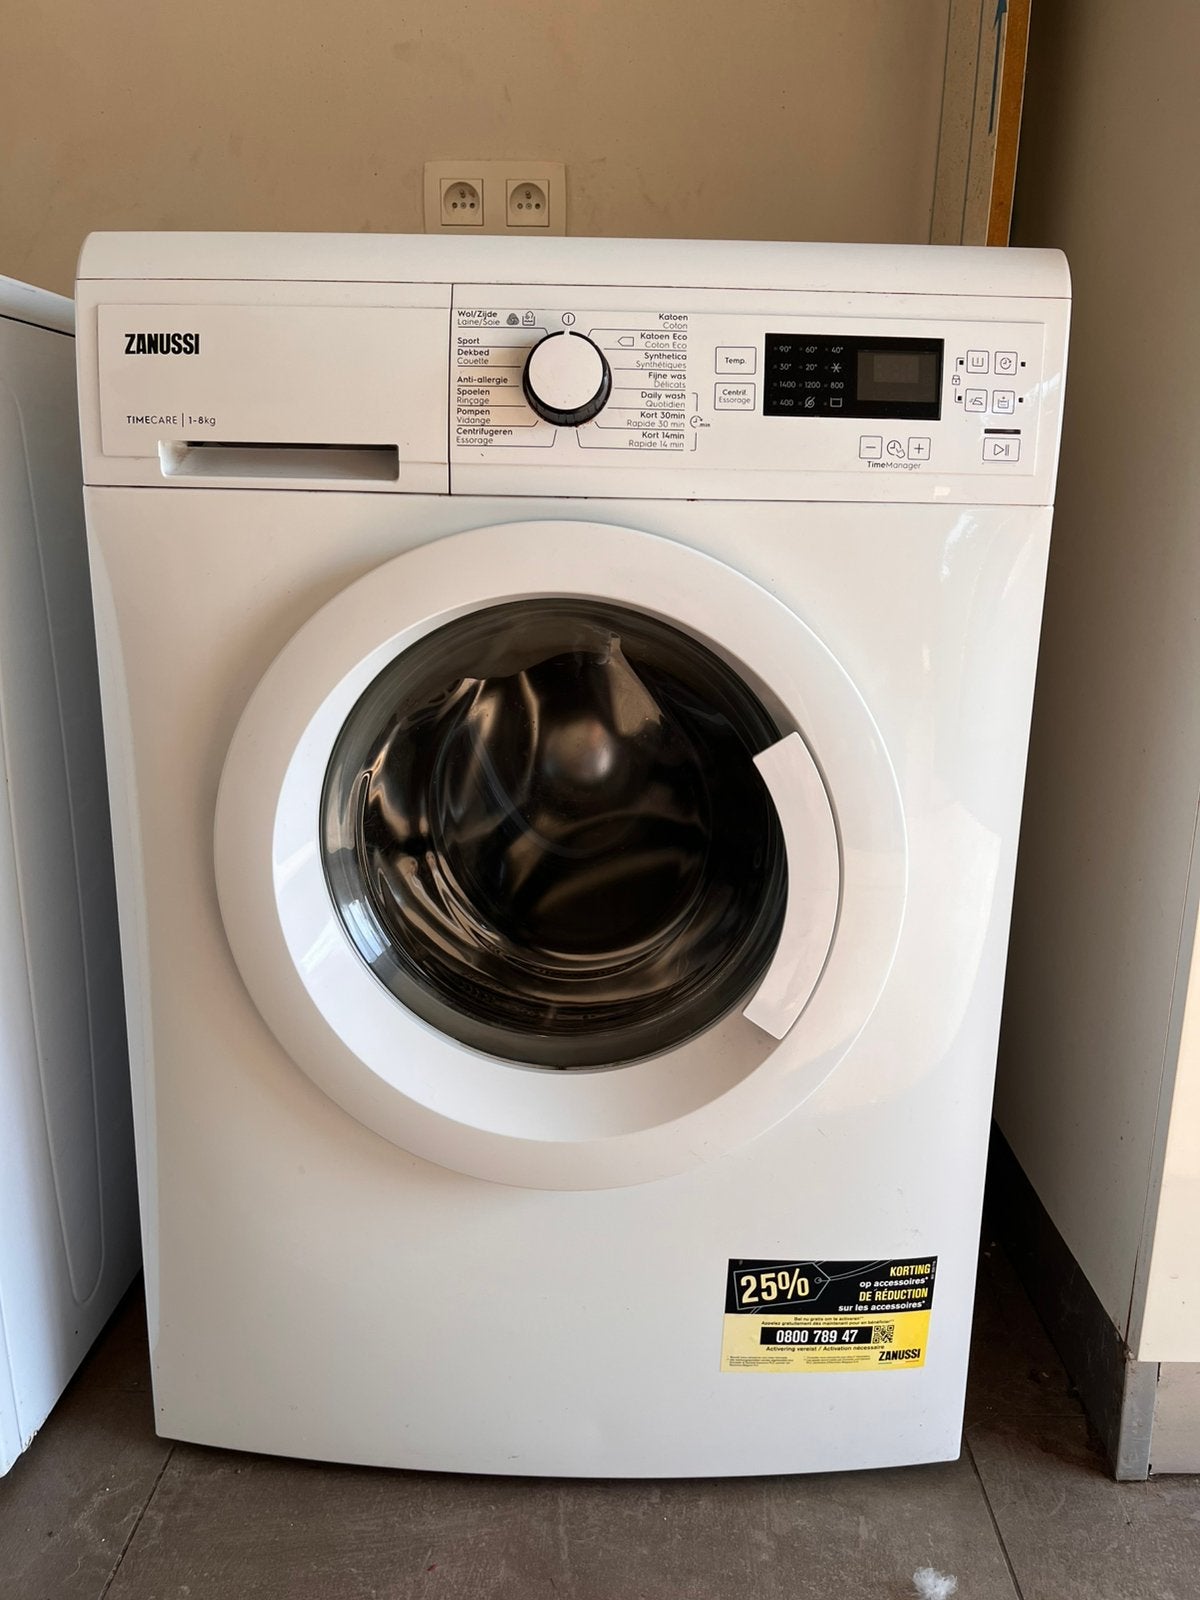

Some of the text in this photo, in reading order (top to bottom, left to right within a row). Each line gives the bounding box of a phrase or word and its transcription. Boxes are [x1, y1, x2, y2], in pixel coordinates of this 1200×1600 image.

[458, 310, 498, 320] Wol/Zijde
[124, 333, 200, 354] ZANUSSI
[457, 337, 480, 345] Sport
[644, 352, 687, 360] Synthetica
[636, 360, 686, 370] Synthétiques
[457, 376, 508, 385] Anti-allergie
[648, 372, 668, 380] Fijne
[457, 388, 490, 397] Spoelen
[641, 391, 661, 400] Daily
[457, 397, 490, 406] Rinçage
[645, 400, 685, 408] Quotidien
[718, 396, 751, 404] Essorage
[457, 408, 490, 416] Pompen
[127, 415, 216, 426] TIMECARE 1-8kg
[457, 417, 491, 426] Vidange
[456, 428, 513, 436] Centrifugeren
[456, 436, 493, 446] Essorage
[628, 440, 657, 448] Rapide
[867, 461, 921, 470] TimeManager
[890, 1264, 931, 1277] KORTING
[740, 1268, 809, 1304] 25%
[859, 1288, 928, 1301] DE RÉDUCTION
[776, 1330, 858, 1343] 0800 789 47
[879, 1348, 921, 1361] ZANUSSI
